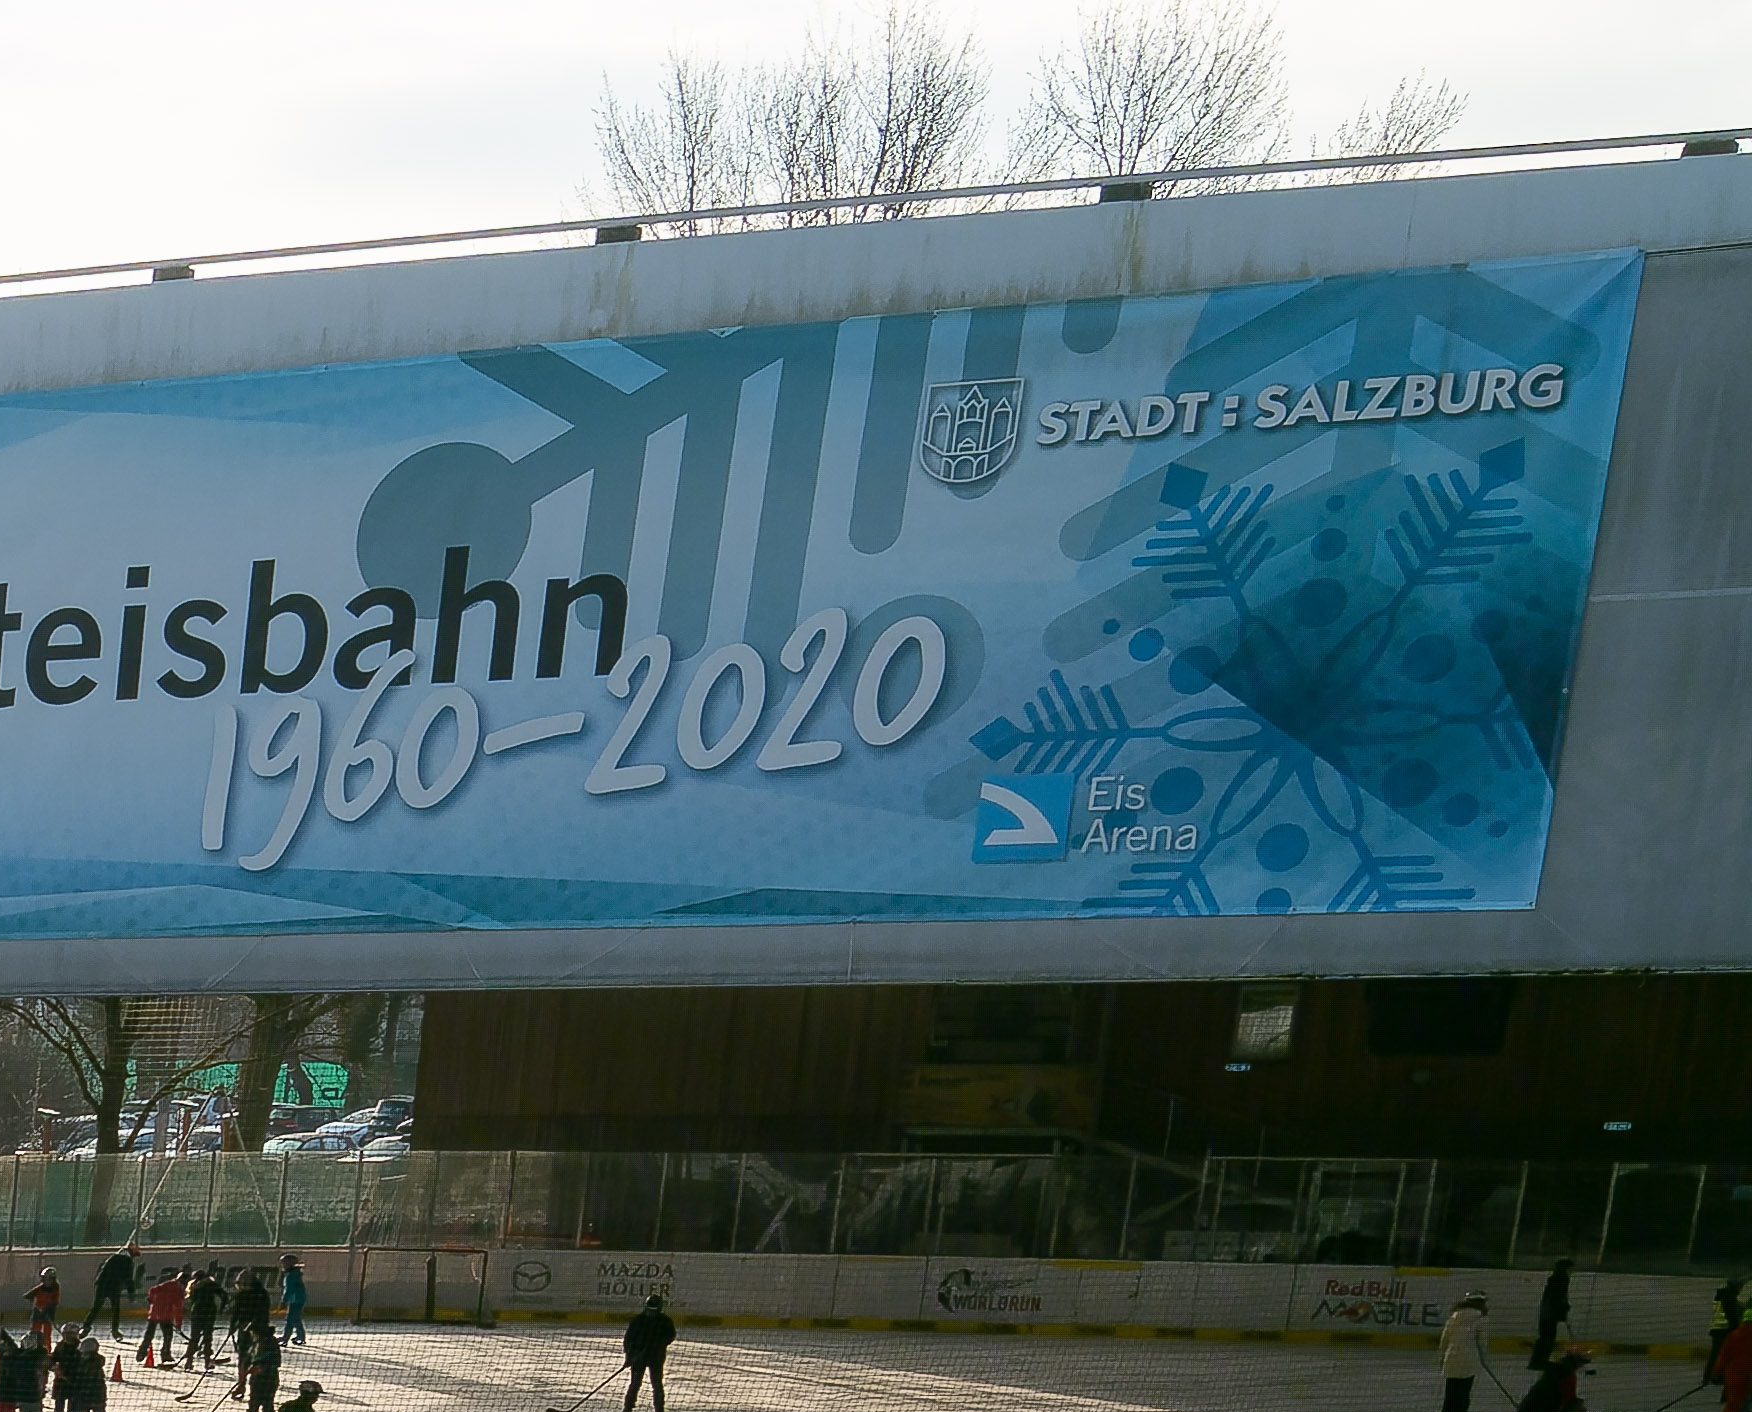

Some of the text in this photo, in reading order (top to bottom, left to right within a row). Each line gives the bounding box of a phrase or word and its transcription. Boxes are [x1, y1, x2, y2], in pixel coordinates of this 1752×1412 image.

[1037, 391, 1211, 446] STADT
[1252, 364, 1566, 430] SALZBURG
[1086, 776, 1146, 812] Eis
[1080, 819, 1197, 856] Arena
[598, 1263, 674, 1279] MAZDA
[1324, 1278, 1406, 1300] Red Bull
